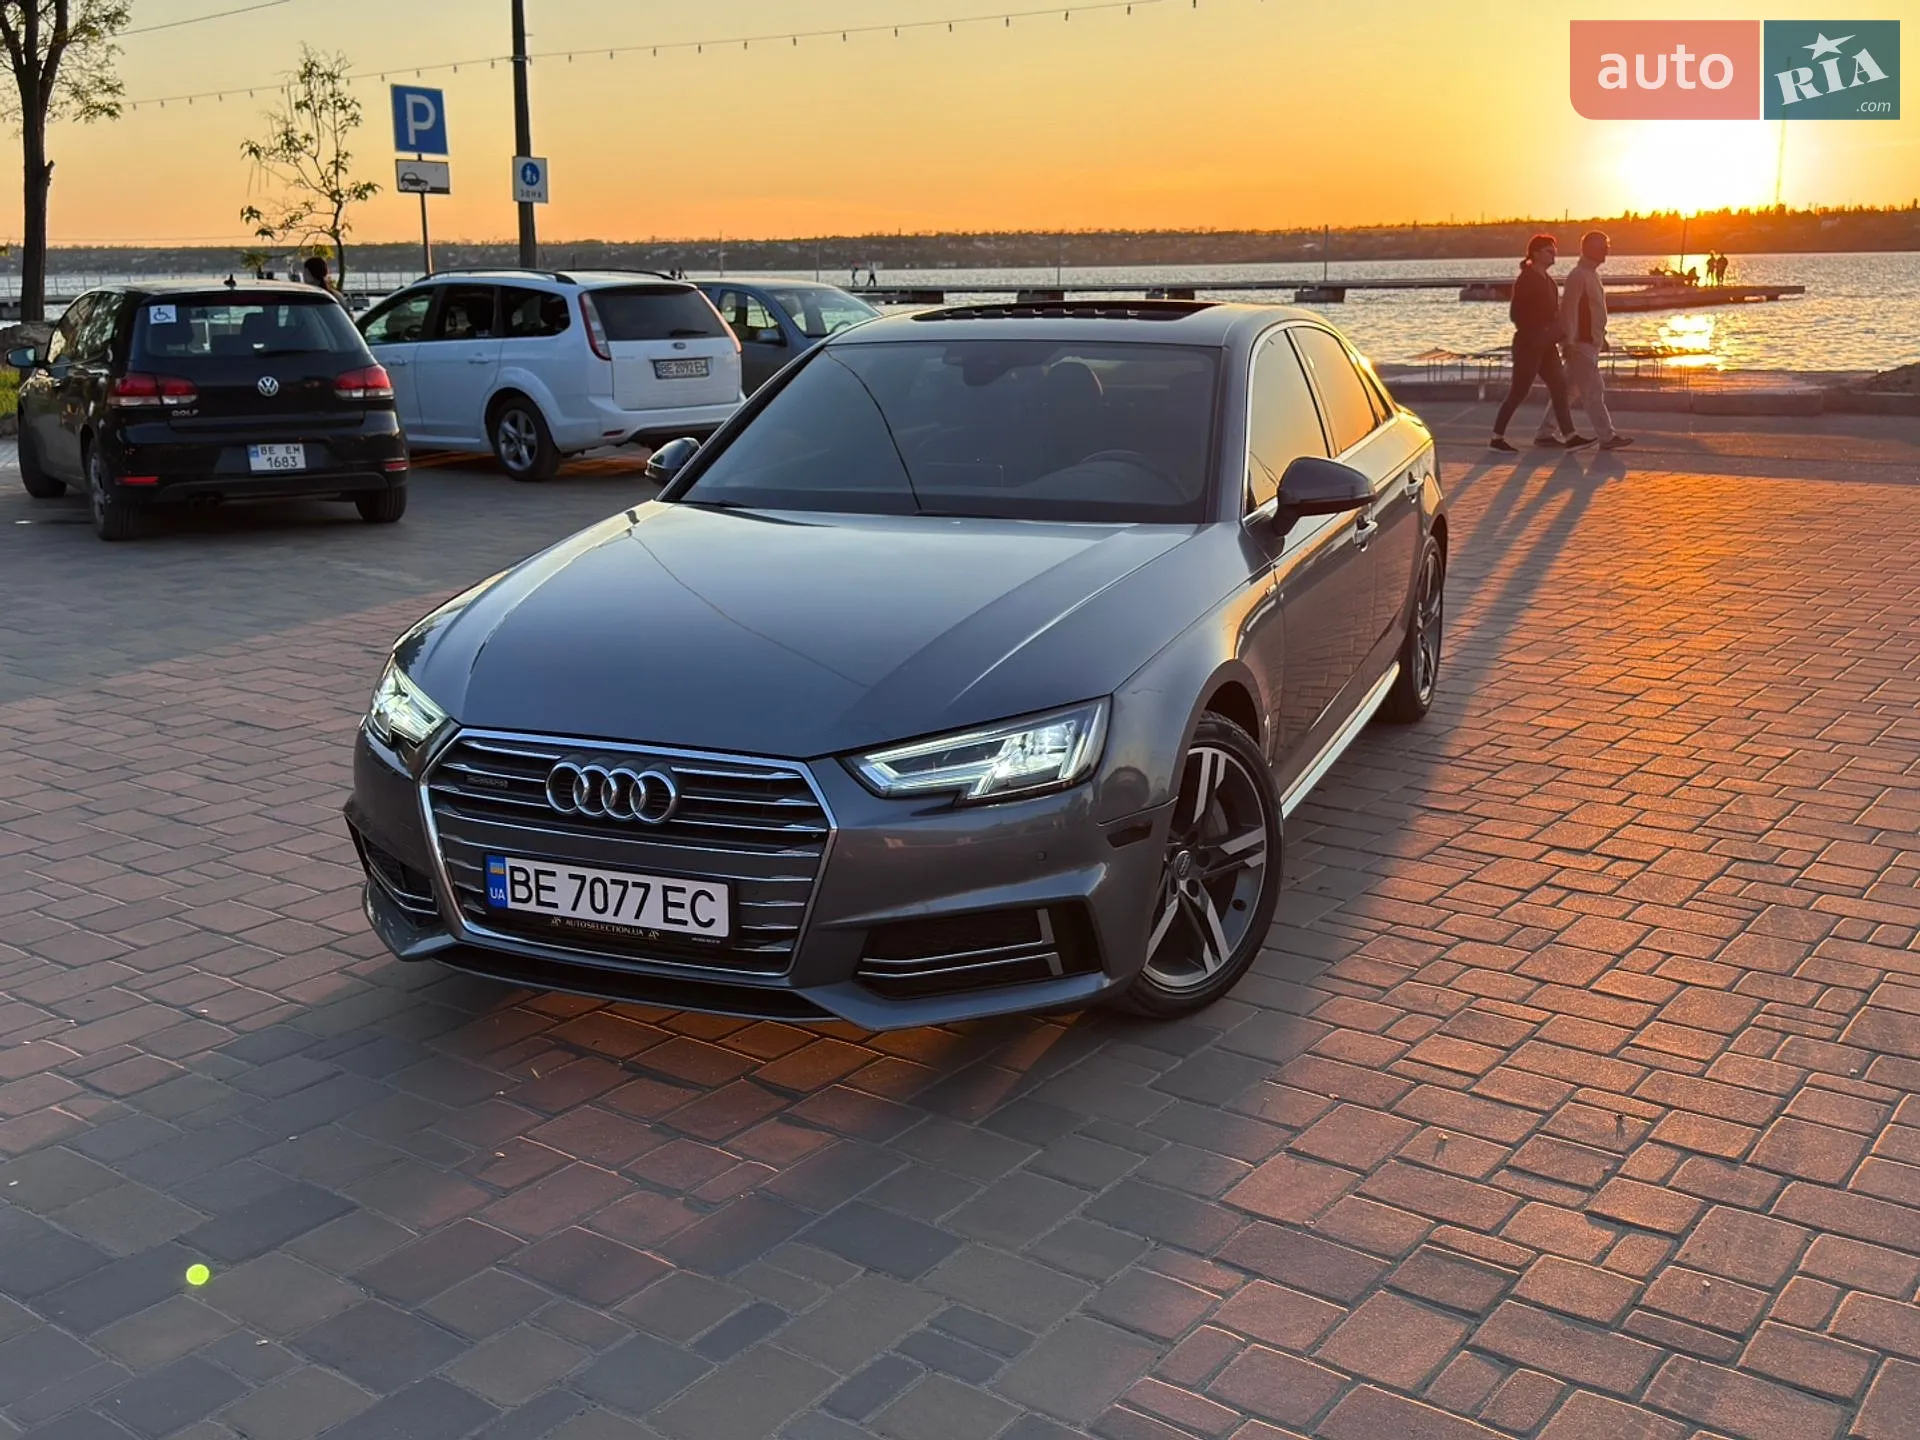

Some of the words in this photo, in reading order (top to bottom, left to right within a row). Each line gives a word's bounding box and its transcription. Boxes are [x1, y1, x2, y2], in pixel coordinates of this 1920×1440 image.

[405, 93, 436, 145] P
[267, 456, 297, 468] 1683
[490, 887, 506, 901] UA
[509, 865, 559, 909] BE
[568, 873, 651, 920] 7077
[661, 885, 716, 928] EC
